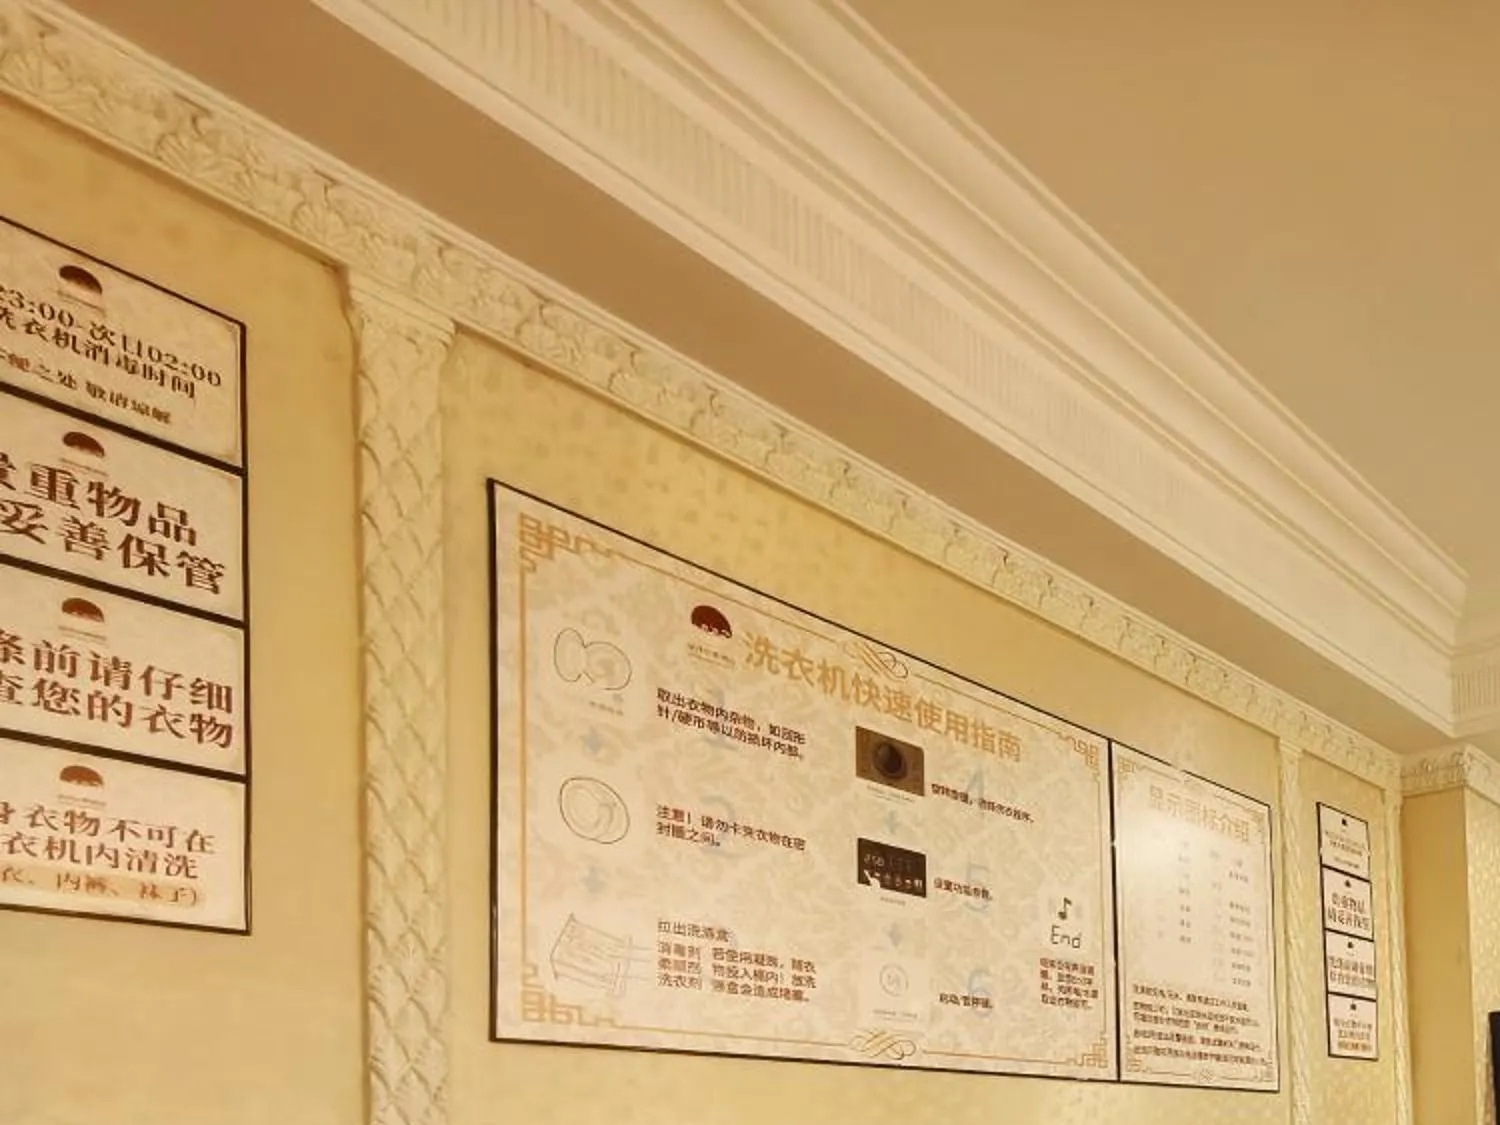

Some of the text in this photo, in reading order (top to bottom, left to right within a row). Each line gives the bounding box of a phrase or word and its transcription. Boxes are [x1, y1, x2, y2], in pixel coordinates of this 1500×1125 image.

[743, 632, 1022, 762] 洗衣机快速使用指南
[1050, 925, 1081, 949] End
